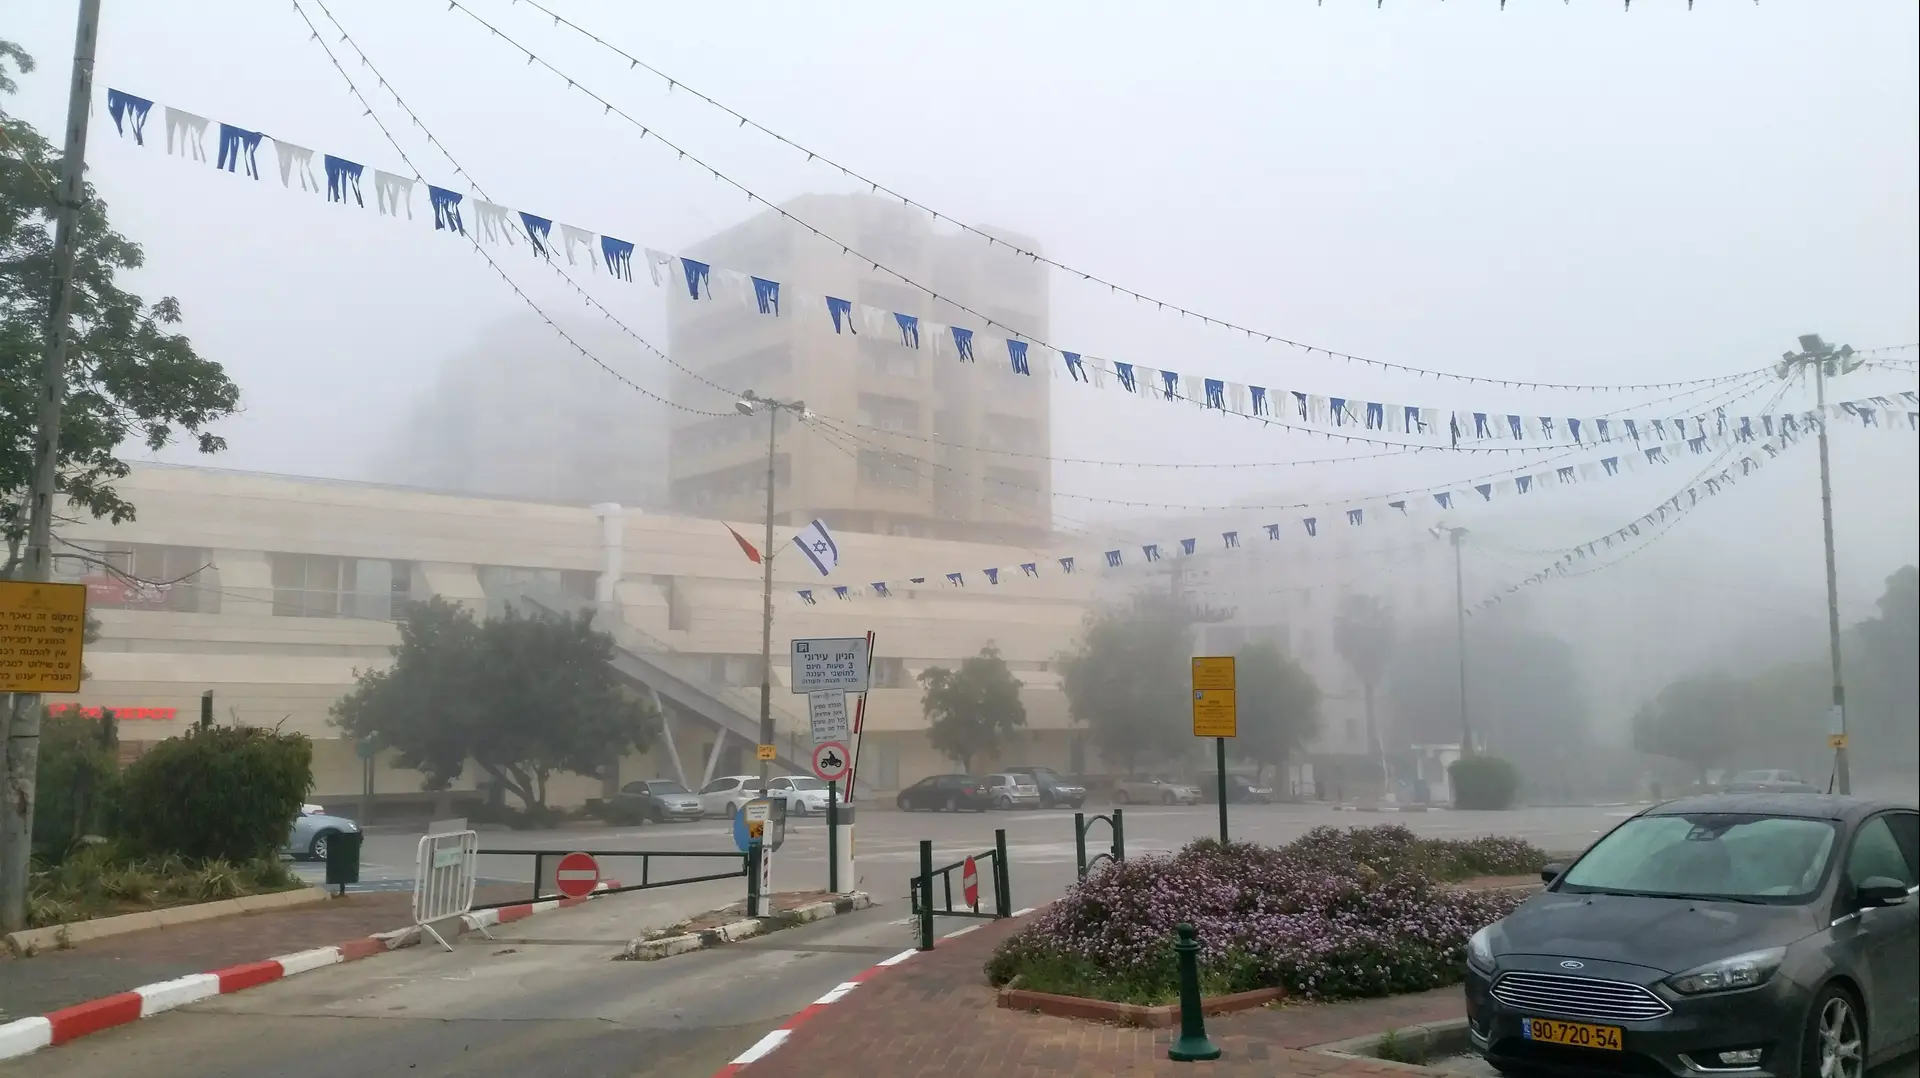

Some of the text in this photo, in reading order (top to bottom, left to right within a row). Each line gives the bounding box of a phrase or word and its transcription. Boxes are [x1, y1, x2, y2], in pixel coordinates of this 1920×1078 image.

[51, 612, 78, 623] במקום
[55, 650, 68, 658] אין
[804, 652, 855, 662] חניון עירוני
[0, 659, 23, 668] למכיר
[28, 660, 53, 668] שילוט
